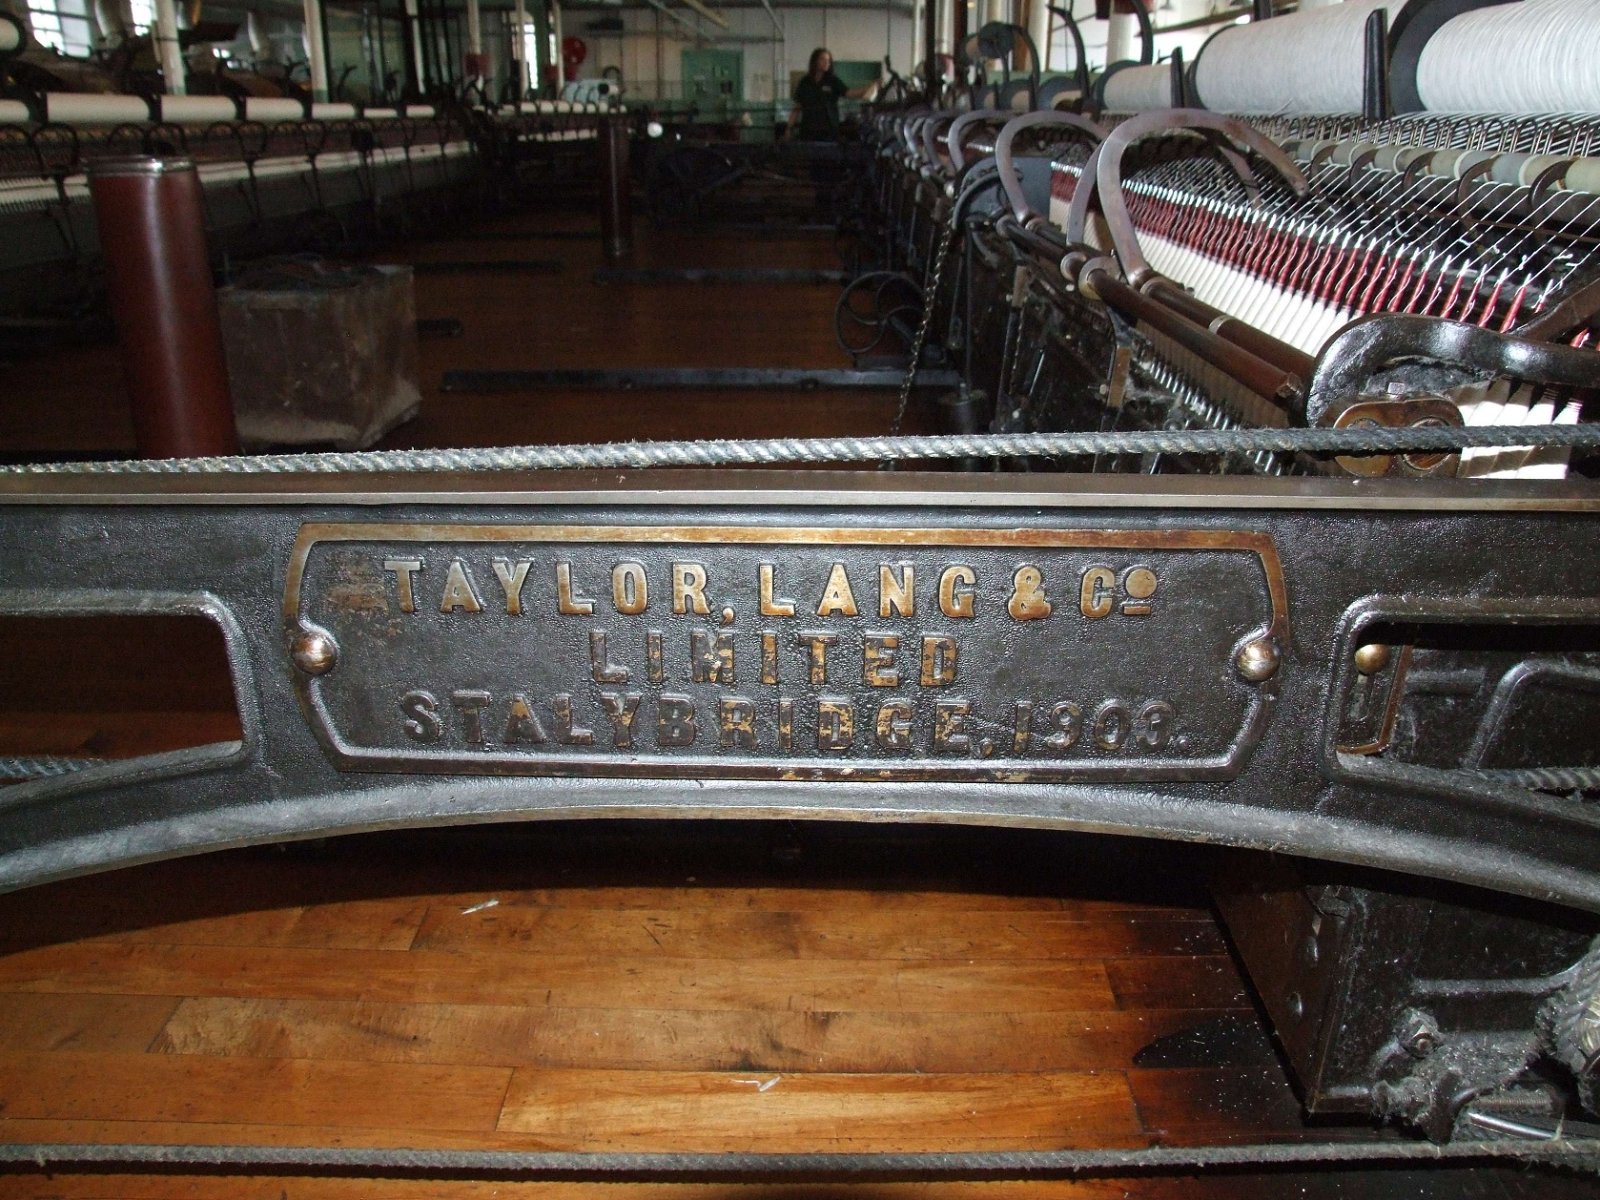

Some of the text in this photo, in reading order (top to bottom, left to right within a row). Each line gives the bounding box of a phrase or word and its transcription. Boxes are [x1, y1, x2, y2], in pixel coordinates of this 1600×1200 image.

[384, 557, 735, 624] TAYLOR,
[757, 562, 977, 618] LANG
[1007, 565, 1053, 621] &
[589, 631, 958, 687] LIMITED
